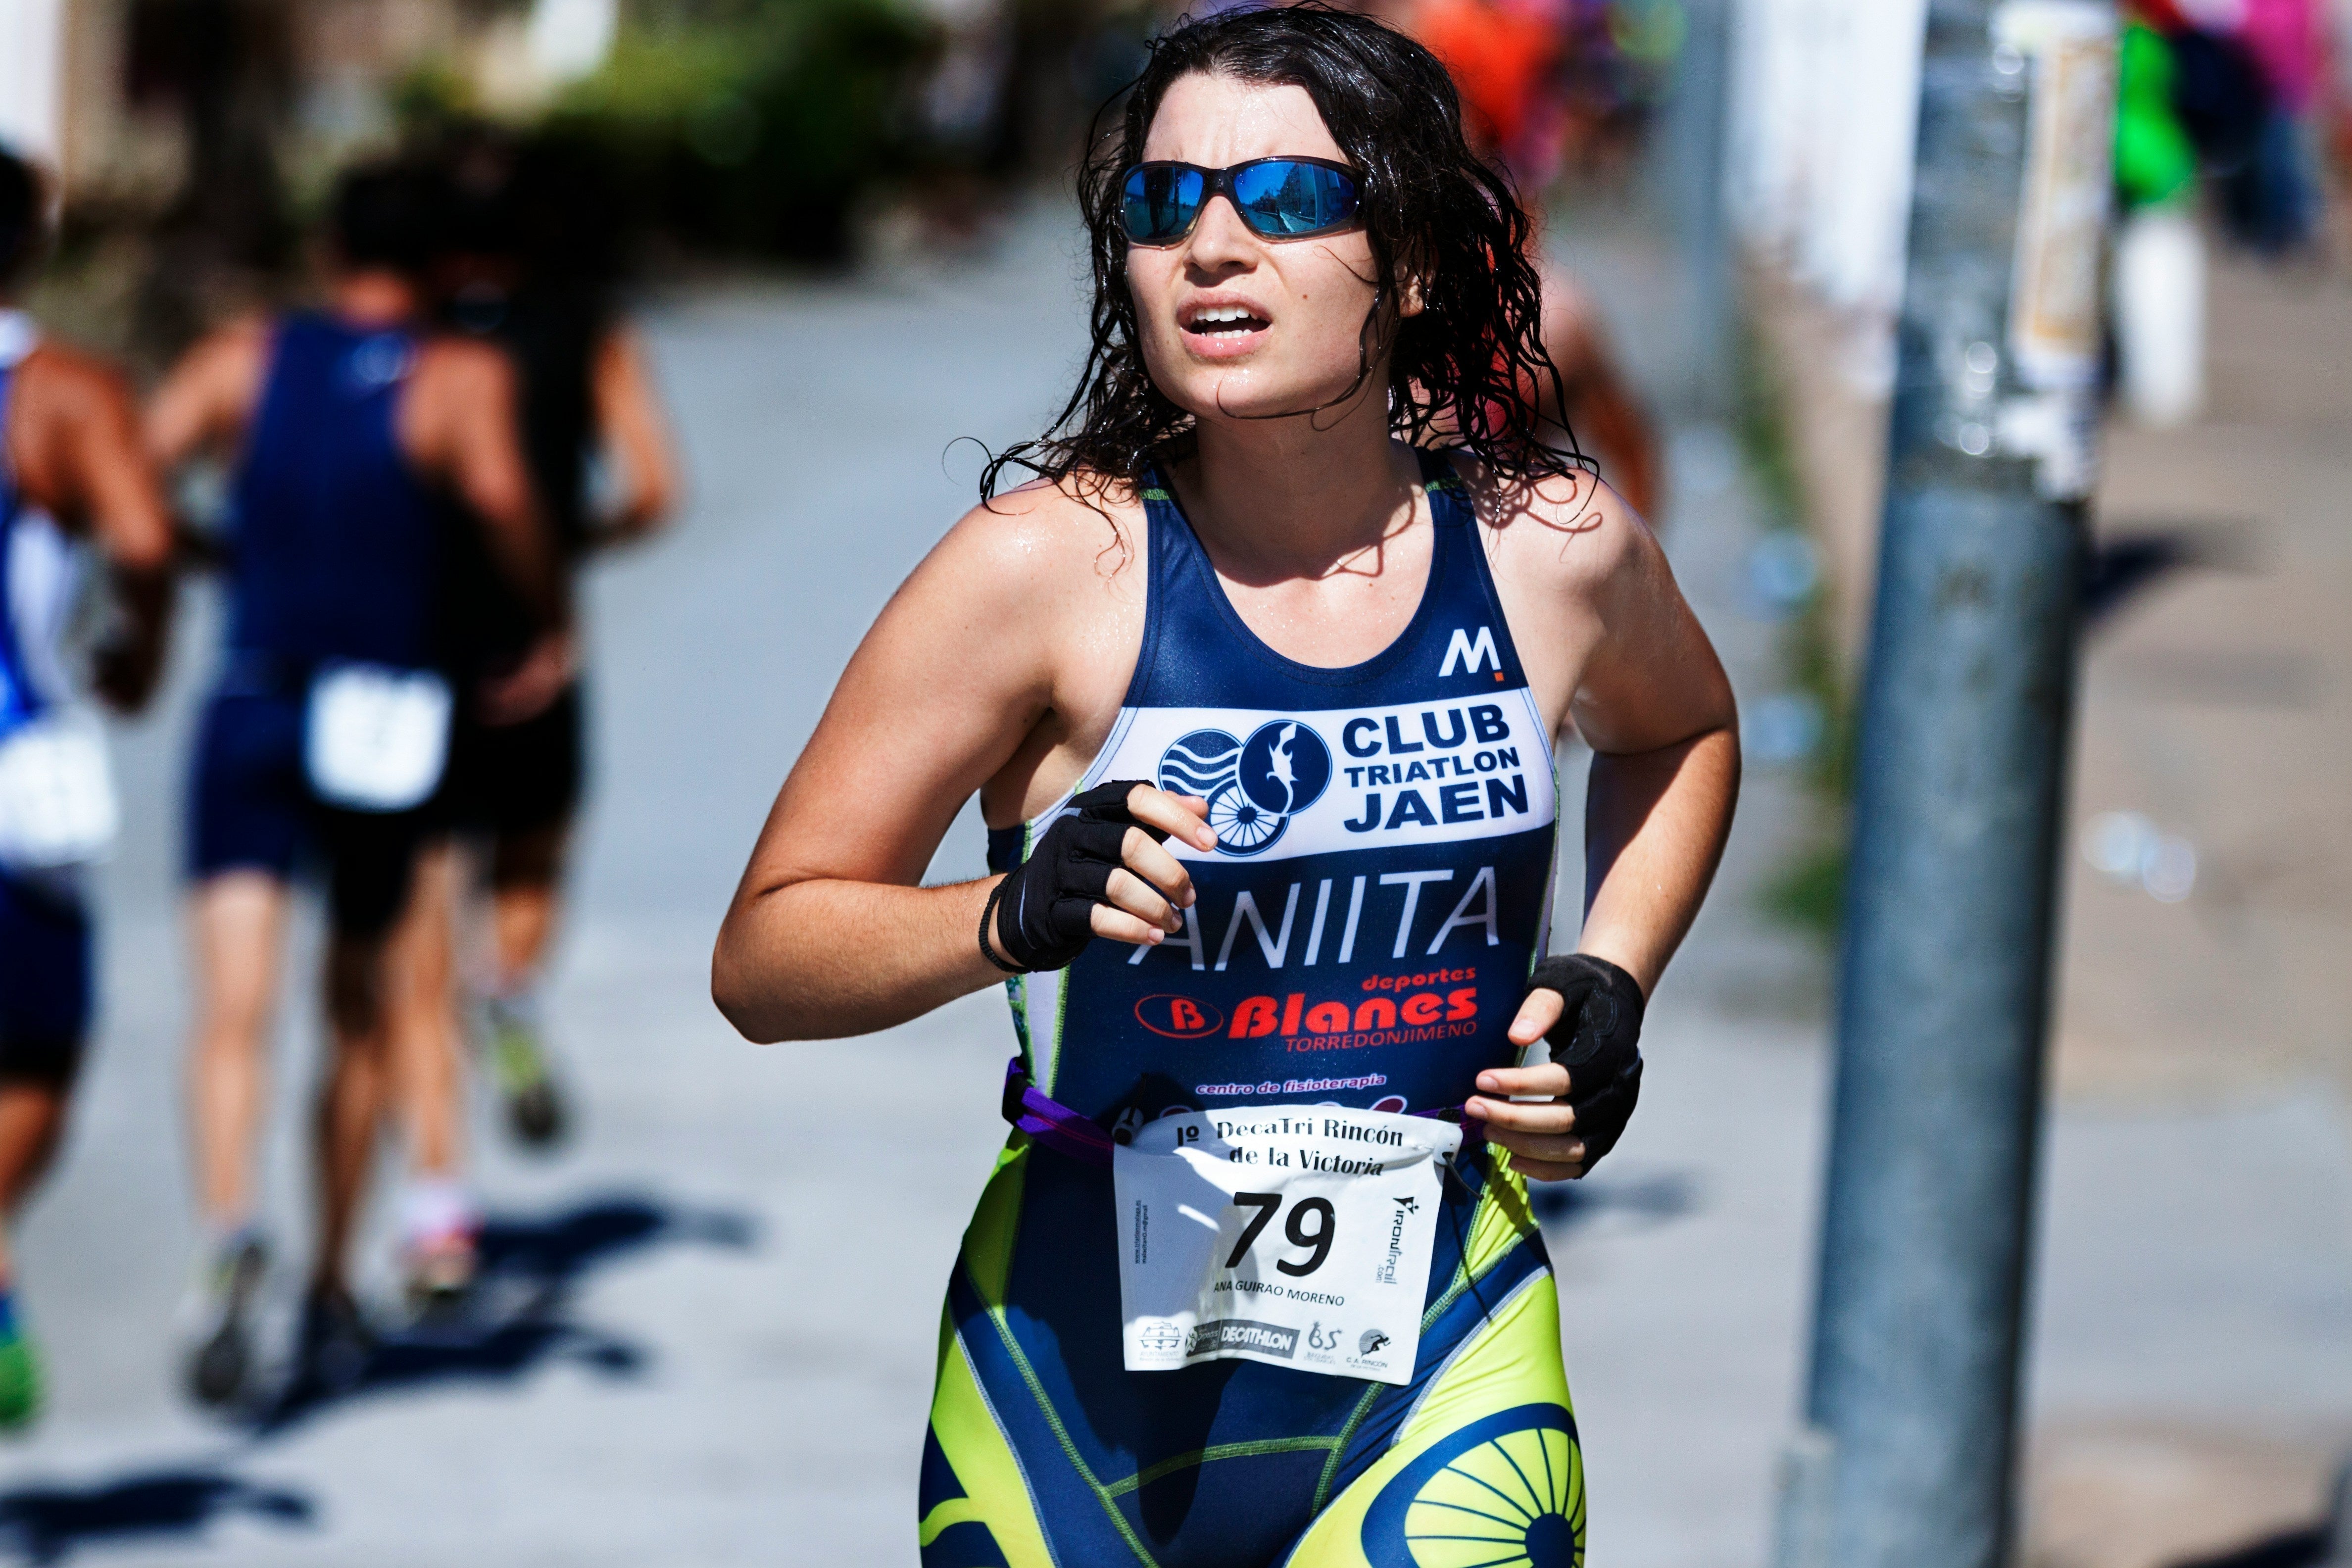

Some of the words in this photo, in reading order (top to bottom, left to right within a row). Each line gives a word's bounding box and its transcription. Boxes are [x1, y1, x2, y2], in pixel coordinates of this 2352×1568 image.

[1343, 704, 1510, 758] CLUB
[1344, 746, 1520, 788] TRIATLON
[1344, 774, 1529, 833] JAEN
[1127, 866, 1499, 971] ANIITA
[1362, 967, 1476, 993] deportes
[1228, 987, 1478, 1039] Blanes
[1287, 1021, 1477, 1053] TORREDONJIMENO
[1196, 1083, 1255, 1095] centro
[1257, 1080, 1280, 1095] de
[1283, 1073, 1387, 1093] fisioterapia
[1216, 1118, 1314, 1139] DecaTri
[1323, 1119, 1404, 1147] Rincón
[1229, 1146, 1259, 1165] de
[1269, 1147, 1290, 1168] la
[1299, 1149, 1385, 1177] Victoria
[1225, 1191, 1336, 1277] 79
[1214, 1280, 1232, 1293] ANA
[1234, 1280, 1284, 1296] GUIRAO
[1286, 1288, 1345, 1307] MORENO
[1220, 1326, 1293, 1352] DECATHLON
